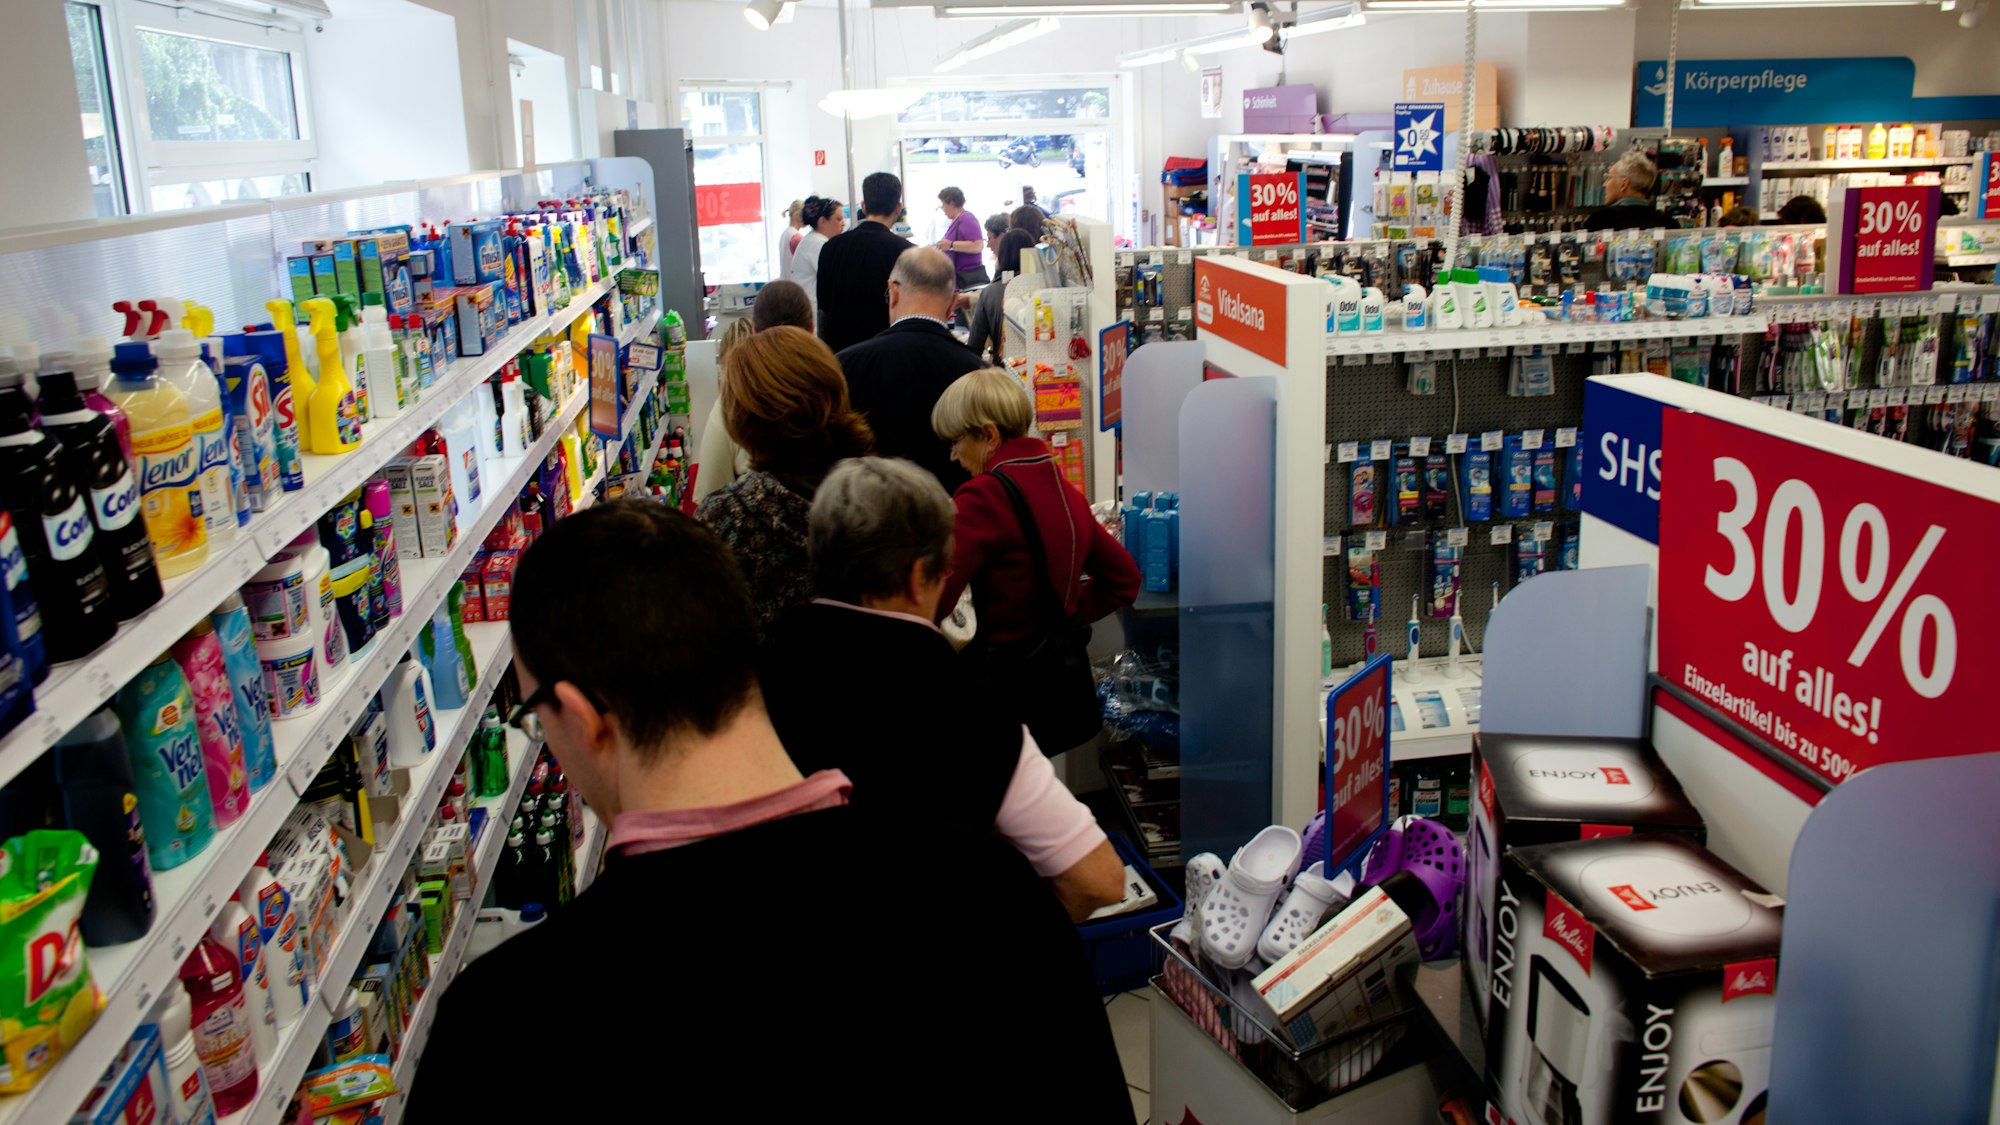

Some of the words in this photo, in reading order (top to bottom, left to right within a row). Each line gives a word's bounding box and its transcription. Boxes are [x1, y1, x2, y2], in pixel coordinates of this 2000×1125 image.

[1423, 77, 1464, 97] Zuhause
[1685, 68, 1808, 94] Körperpflege
[1252, 94, 1278, 109] Schönheit
[1251, 181, 1298, 207] 30%
[1252, 208, 1271, 223] auf
[1270, 207, 1298, 222] alles!
[1860, 200, 1923, 235] 30%
[1857, 239, 1883, 257] auf
[1881, 238, 1921, 257] alles!
[1217, 287, 1265, 332] Vitalsana
[1339, 299, 1357, 312] Odol
[1364, 303, 1380, 315] Odol
[1406, 301, 1422, 311] Odol
[140, 447, 194, 496] Lenor
[1703, 456, 1958, 699] 30%
[1741, 641, 1794, 693] auf
[1794, 666, 1883, 746] alles!
[213, 701, 236, 736] Ver
[1333, 686, 1385, 775] 30%
[1683, 664, 1773, 736] Einzelartikel
[1773, 715, 1798, 747] bis
[1799, 737, 1819, 765] zu
[158, 733, 193, 774] Ver
[1333, 773, 1353, 813] auf
[1353, 746, 1385, 796] alles!
[1528, 768, 1597, 780] ENJOY
[1648, 881, 1722, 901] ENJOY
[1492, 879, 1521, 1010] ENJOY
[1636, 1003, 1675, 1114] ENJOY
